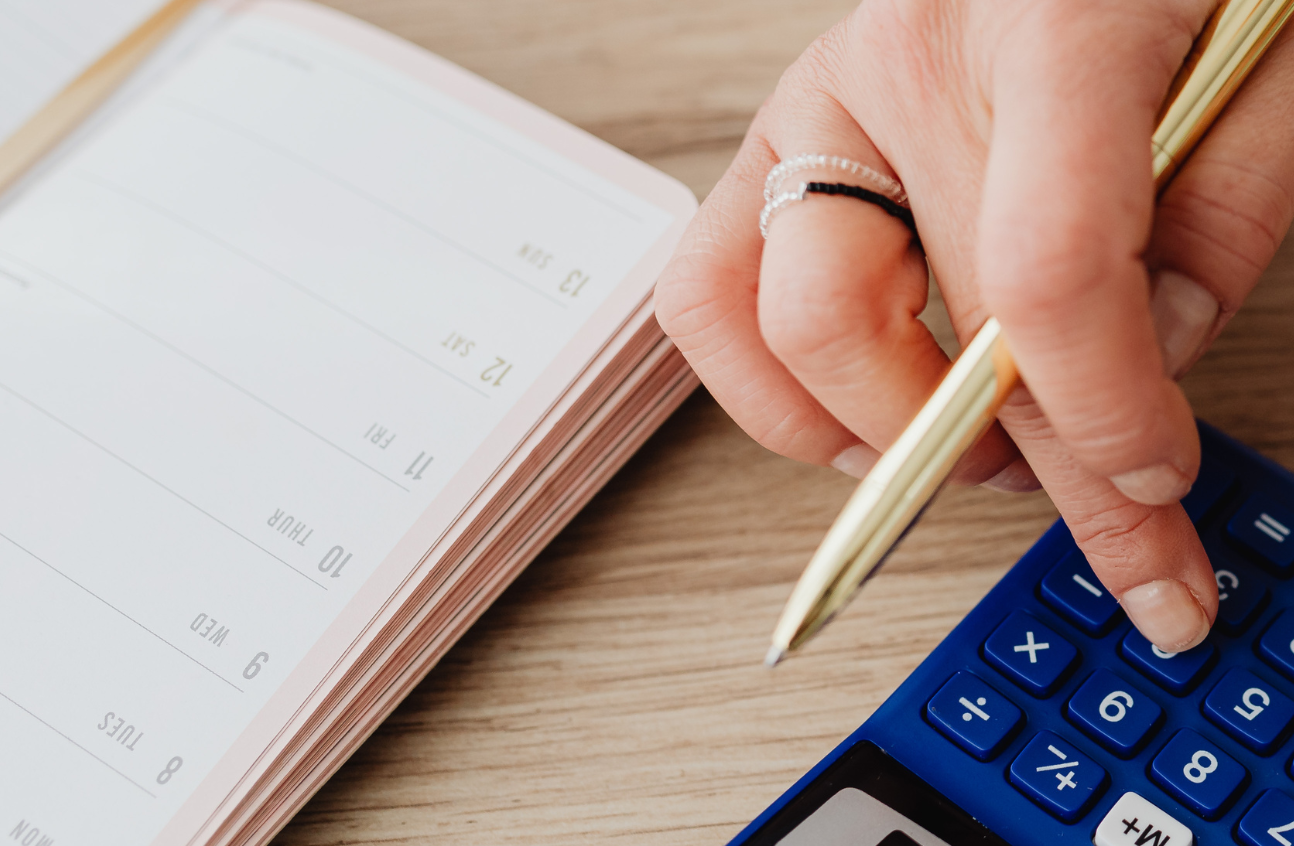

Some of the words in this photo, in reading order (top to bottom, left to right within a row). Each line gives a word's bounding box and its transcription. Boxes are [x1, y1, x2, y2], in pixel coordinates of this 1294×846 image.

[516, 242, 553, 271] SUN
[558, 268, 590, 299] 13
[441, 331, 476, 358] SAT
[479, 356, 513, 388] 12
[363, 422, 397, 451] FRI
[403, 450, 434, 481] 11
[266, 507, 314, 547] THUR
[317, 544, 354, 579] 10
[189, 612, 231, 648] WED
[242, 651, 270, 681] 9
[1098, 690, 1134, 723] 9
[1233, 687, 1270, 721] 5
[97, 711, 144, 752] TUES
[155, 755, 184, 786] 8
[1183, 749, 1219, 784] 8
[8, 819, 55, 846] MON
